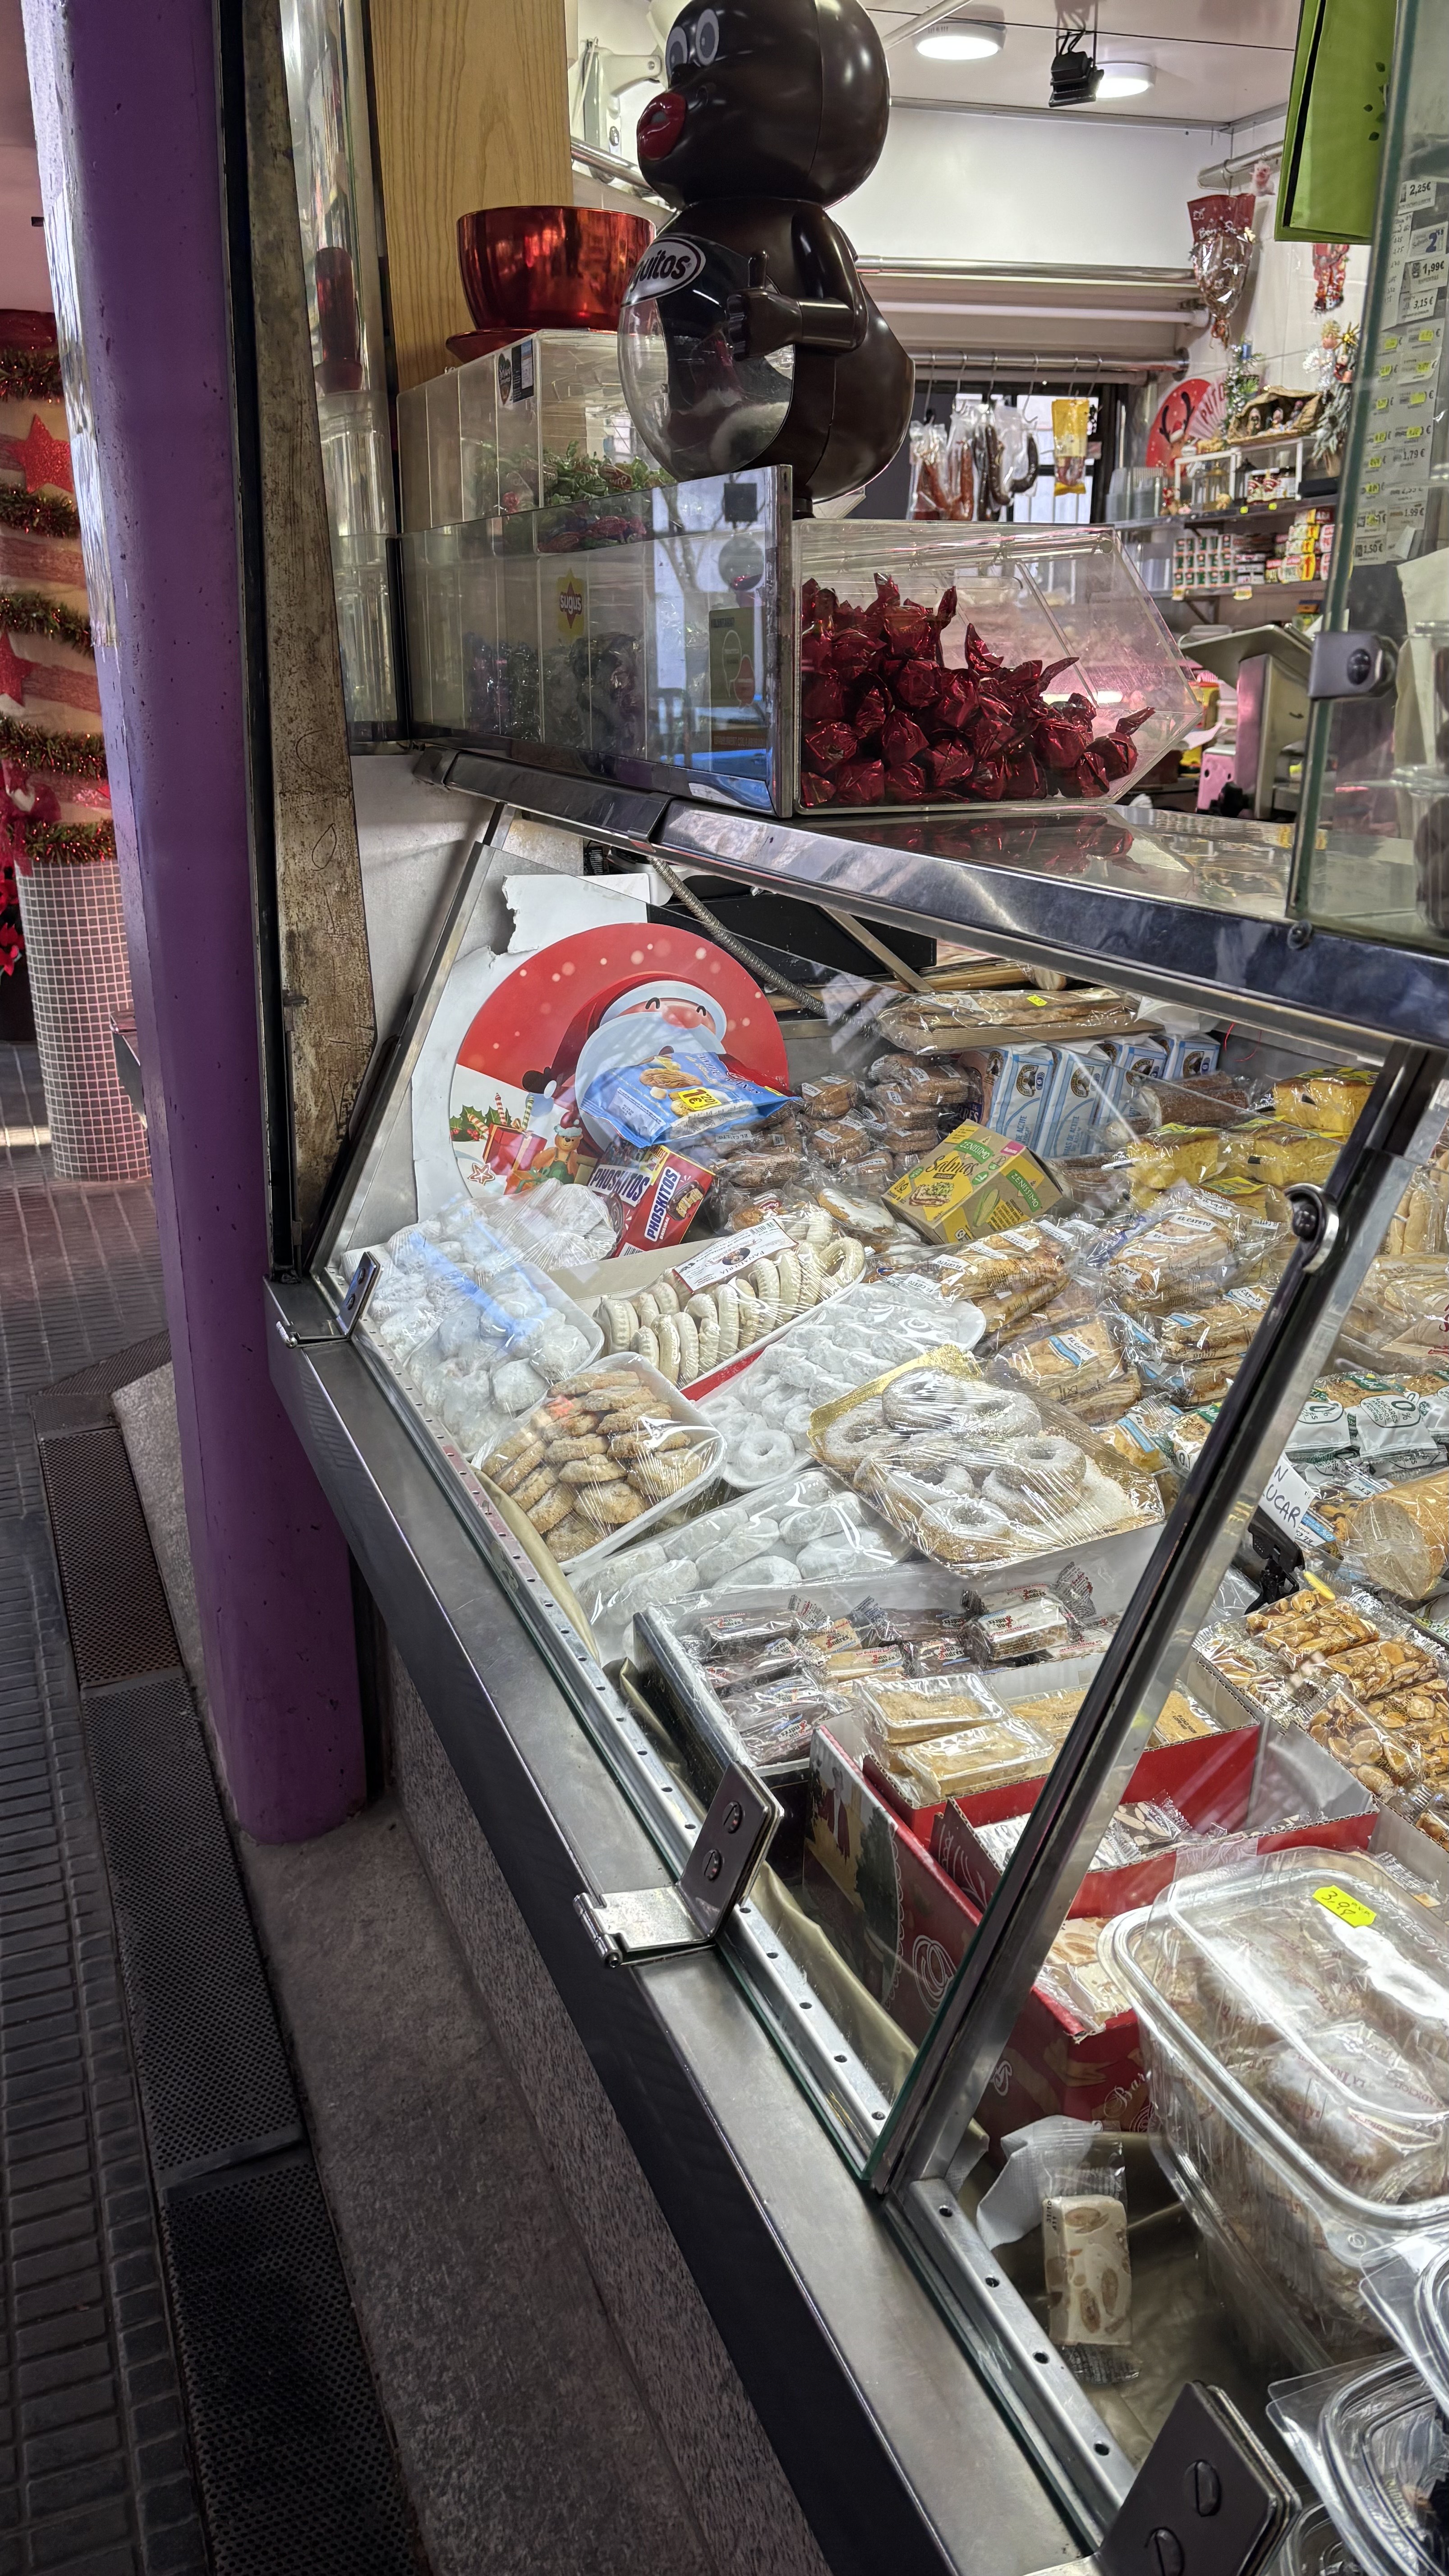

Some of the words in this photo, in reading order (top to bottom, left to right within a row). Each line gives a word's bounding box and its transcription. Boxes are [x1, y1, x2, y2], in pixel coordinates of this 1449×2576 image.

[560, 594, 581, 614] sugus
[960, 1141, 990, 1159] ZENISSIMO
[925, 1155, 979, 1176] Salmas
[590, 1168, 650, 1202] PHOSKITOS
[1011, 1173, 1039, 1207] ZENISSIMO
[647, 1168, 678, 1239] PHOSKITOS
[1187, 1219, 1212, 1227] CATETO
[1263, 1484, 1301, 1528] UCAR
